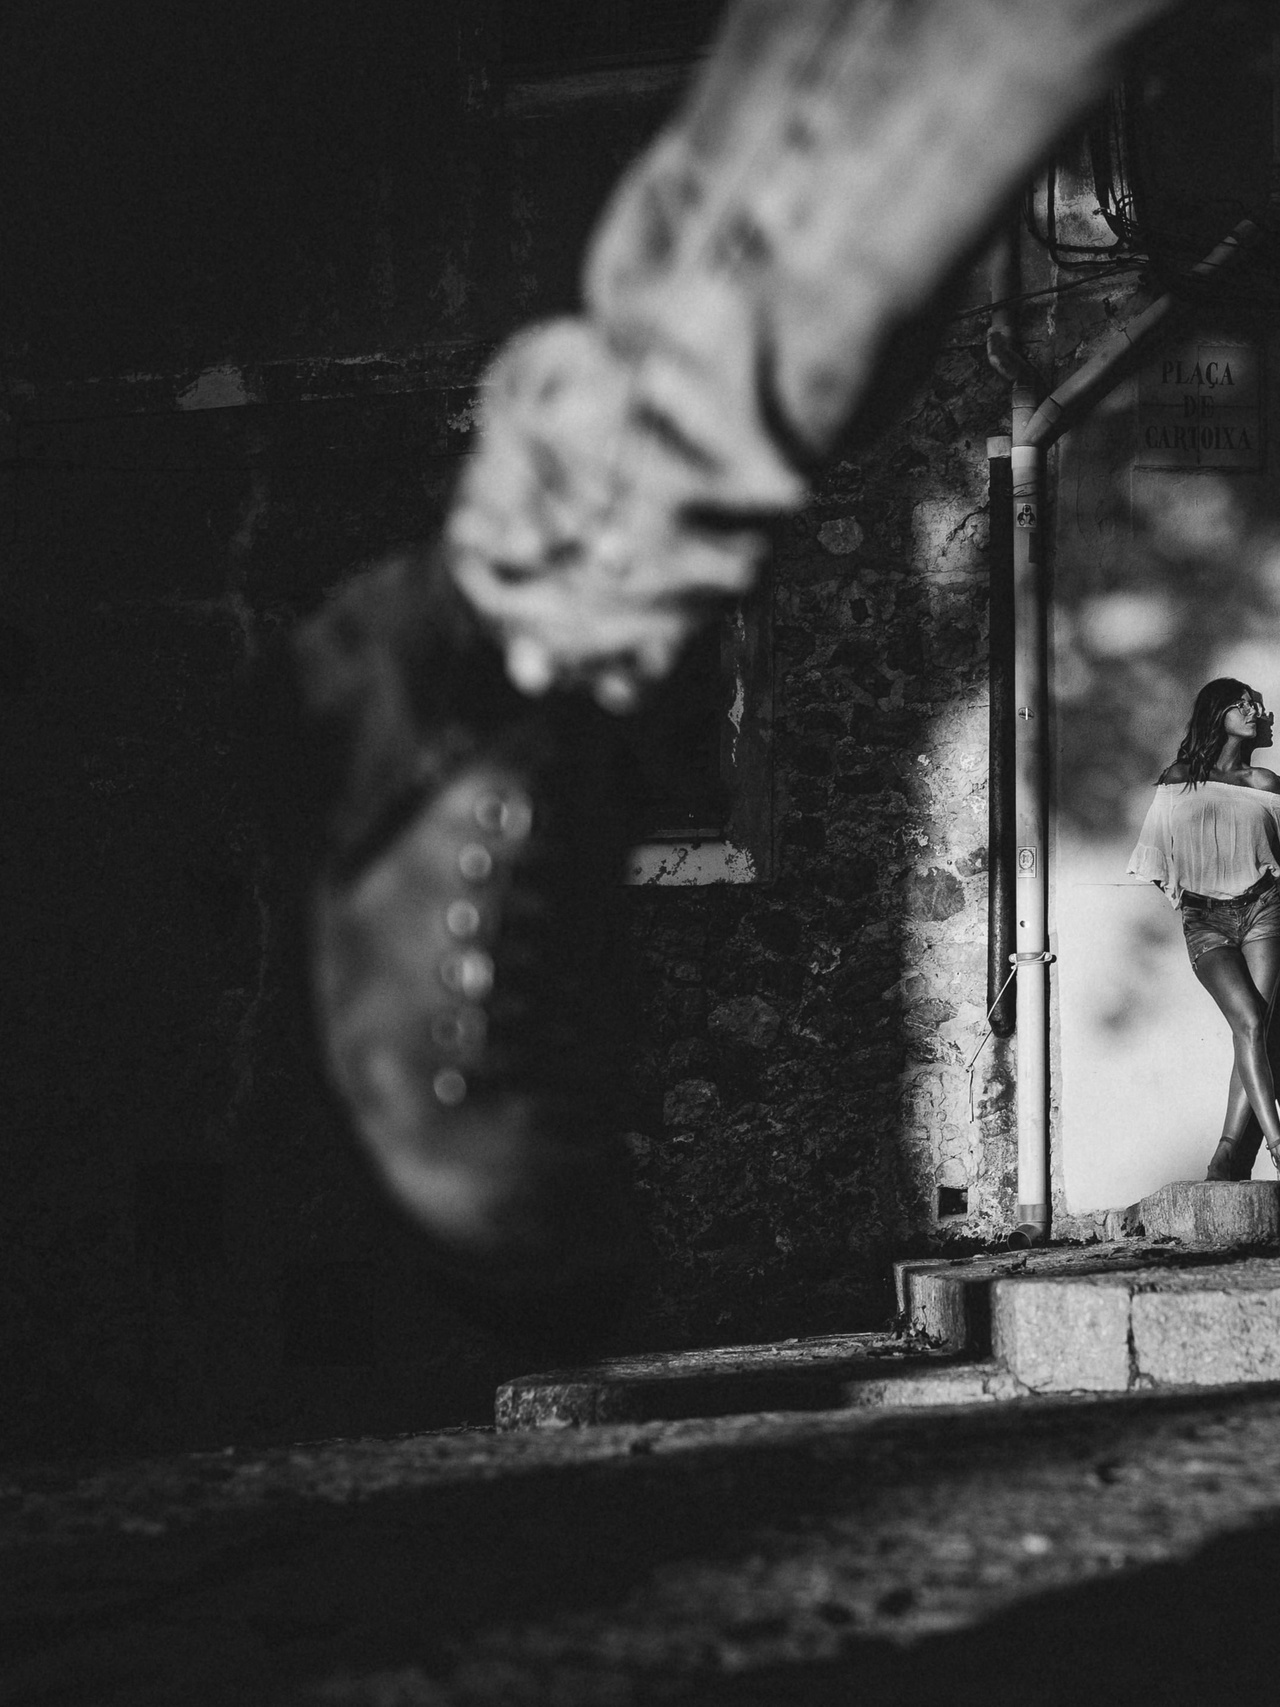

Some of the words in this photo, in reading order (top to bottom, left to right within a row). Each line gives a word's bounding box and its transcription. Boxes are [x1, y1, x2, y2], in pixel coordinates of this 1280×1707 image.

[1161, 360, 1235, 388] PLAÇA
[1183, 395, 1214, 418] DE
[1145, 425, 1251, 450] CARTOIXA
